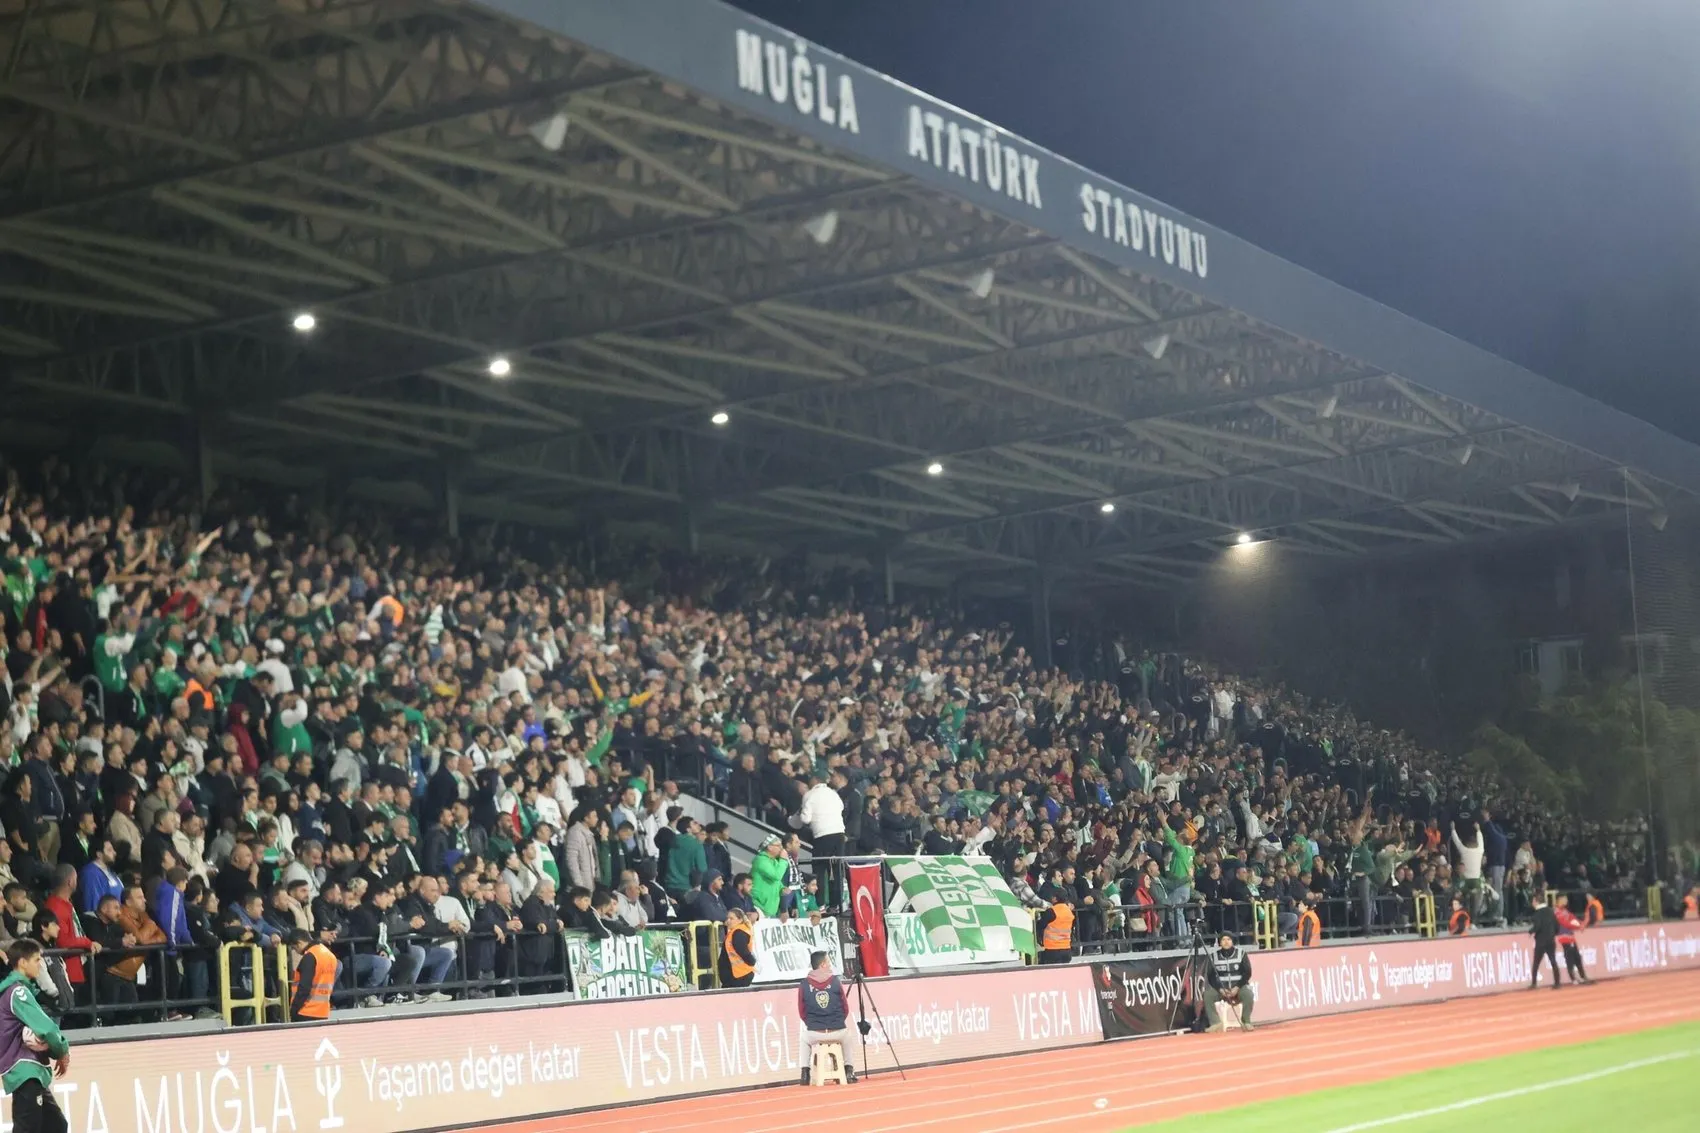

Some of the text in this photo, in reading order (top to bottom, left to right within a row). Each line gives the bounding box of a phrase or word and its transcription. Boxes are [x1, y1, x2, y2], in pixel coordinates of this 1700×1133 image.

[736, 28, 1208, 278] MUĞLA ATATÜRK STADYUMU
[601, 934, 647, 974] BATI
[1463, 952, 1496, 988] VESTA
[1123, 966, 1182, 1010] trendyol
[1273, 968, 1317, 1011] VESTA
[1320, 955, 1367, 1005] MUĞLA
[914, 1003, 954, 1044] değer
[956, 1000, 991, 1034] katar
[1013, 989, 1073, 1041] VESTA
[615, 1002, 801, 1089] VESTA MUĞL
[134, 1050, 297, 1133] MUĞLA
[360, 1040, 581, 1112] Yaşama değer katar
